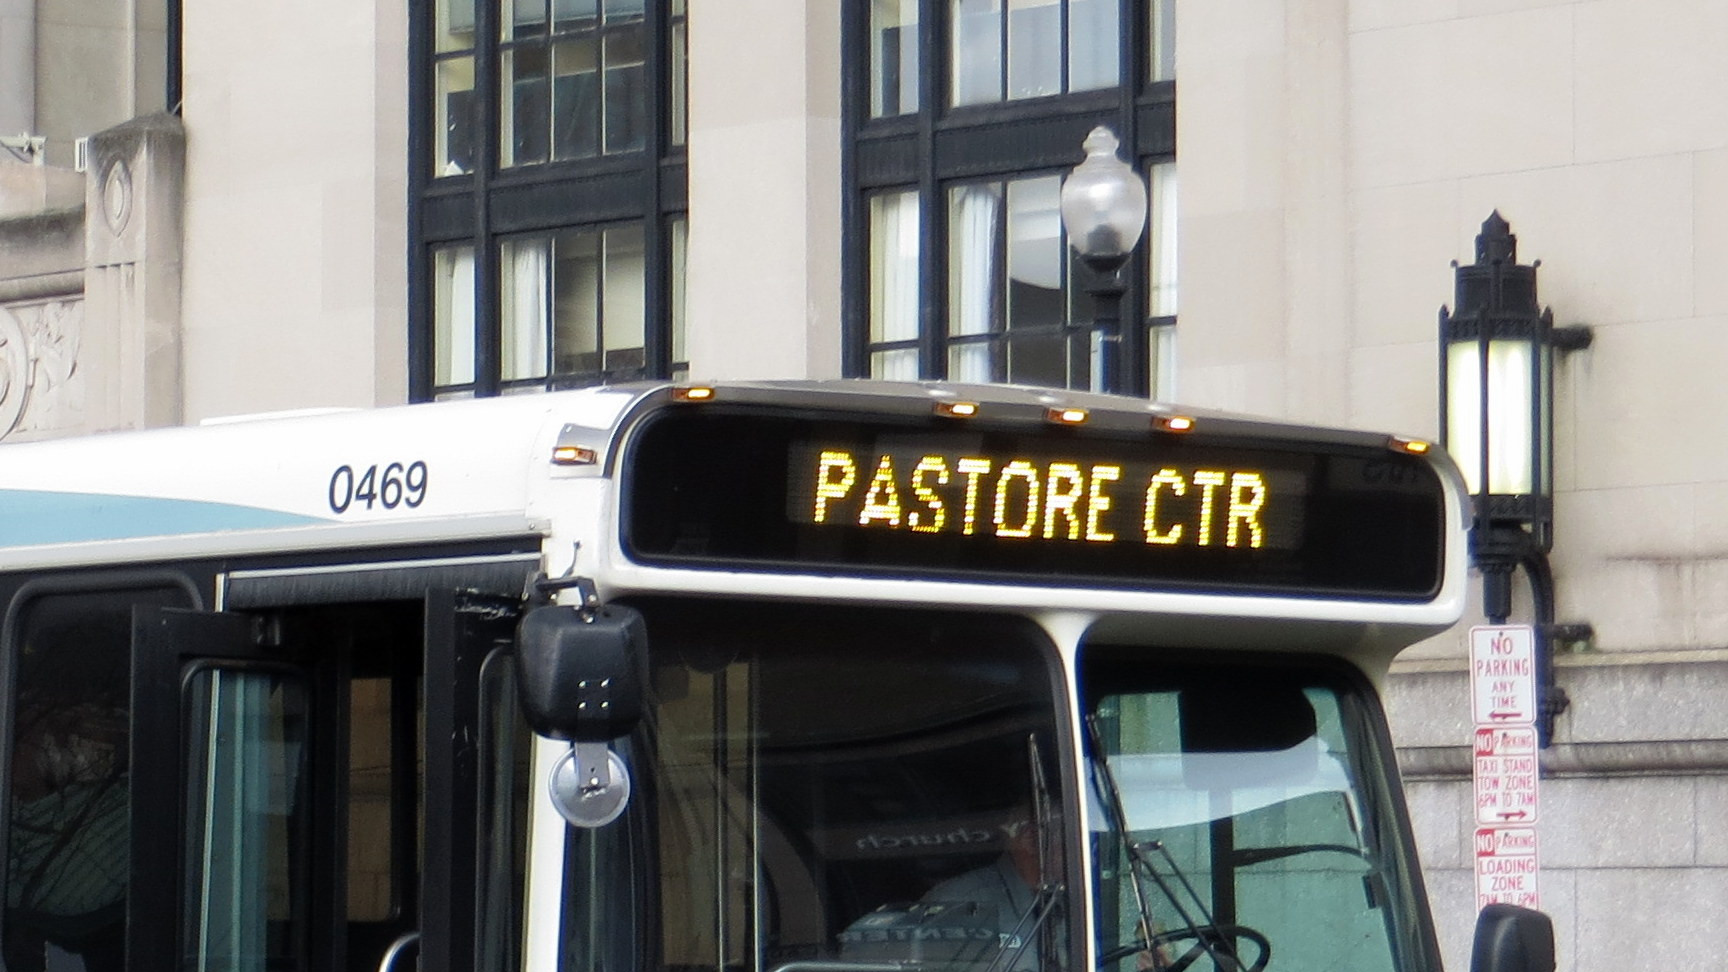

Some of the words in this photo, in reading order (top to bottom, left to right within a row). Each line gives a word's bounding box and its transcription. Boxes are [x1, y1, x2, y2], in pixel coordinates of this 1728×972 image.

[329, 460, 428, 514] 0469
[815, 451, 1121, 542] PASTORE
[1144, 469, 1266, 548] CTR
[1490, 637, 1513, 655] NO
[1476, 658, 1529, 676] PARKING
[1492, 680, 1515, 693] ANY
[1491, 696, 1517, 708] TIME
[1476, 733, 1492, 752] NO
[1494, 734, 1532, 749] PARKING
[1478, 760, 1498, 774] TAXI
[1503, 758, 1532, 774] STAND
[1478, 776, 1499, 790] TOW
[1505, 775, 1533, 790] ZONE
[1479, 793, 1497, 808] 6PM
[1502, 792, 1512, 807] TO
[1517, 791, 1535, 806] 7AM
[1476, 833, 1493, 851] NO
[1495, 834, 1535, 850] PARKING
[1479, 858, 1535, 875] LOADING
[1492, 875, 1524, 891] ZONE
